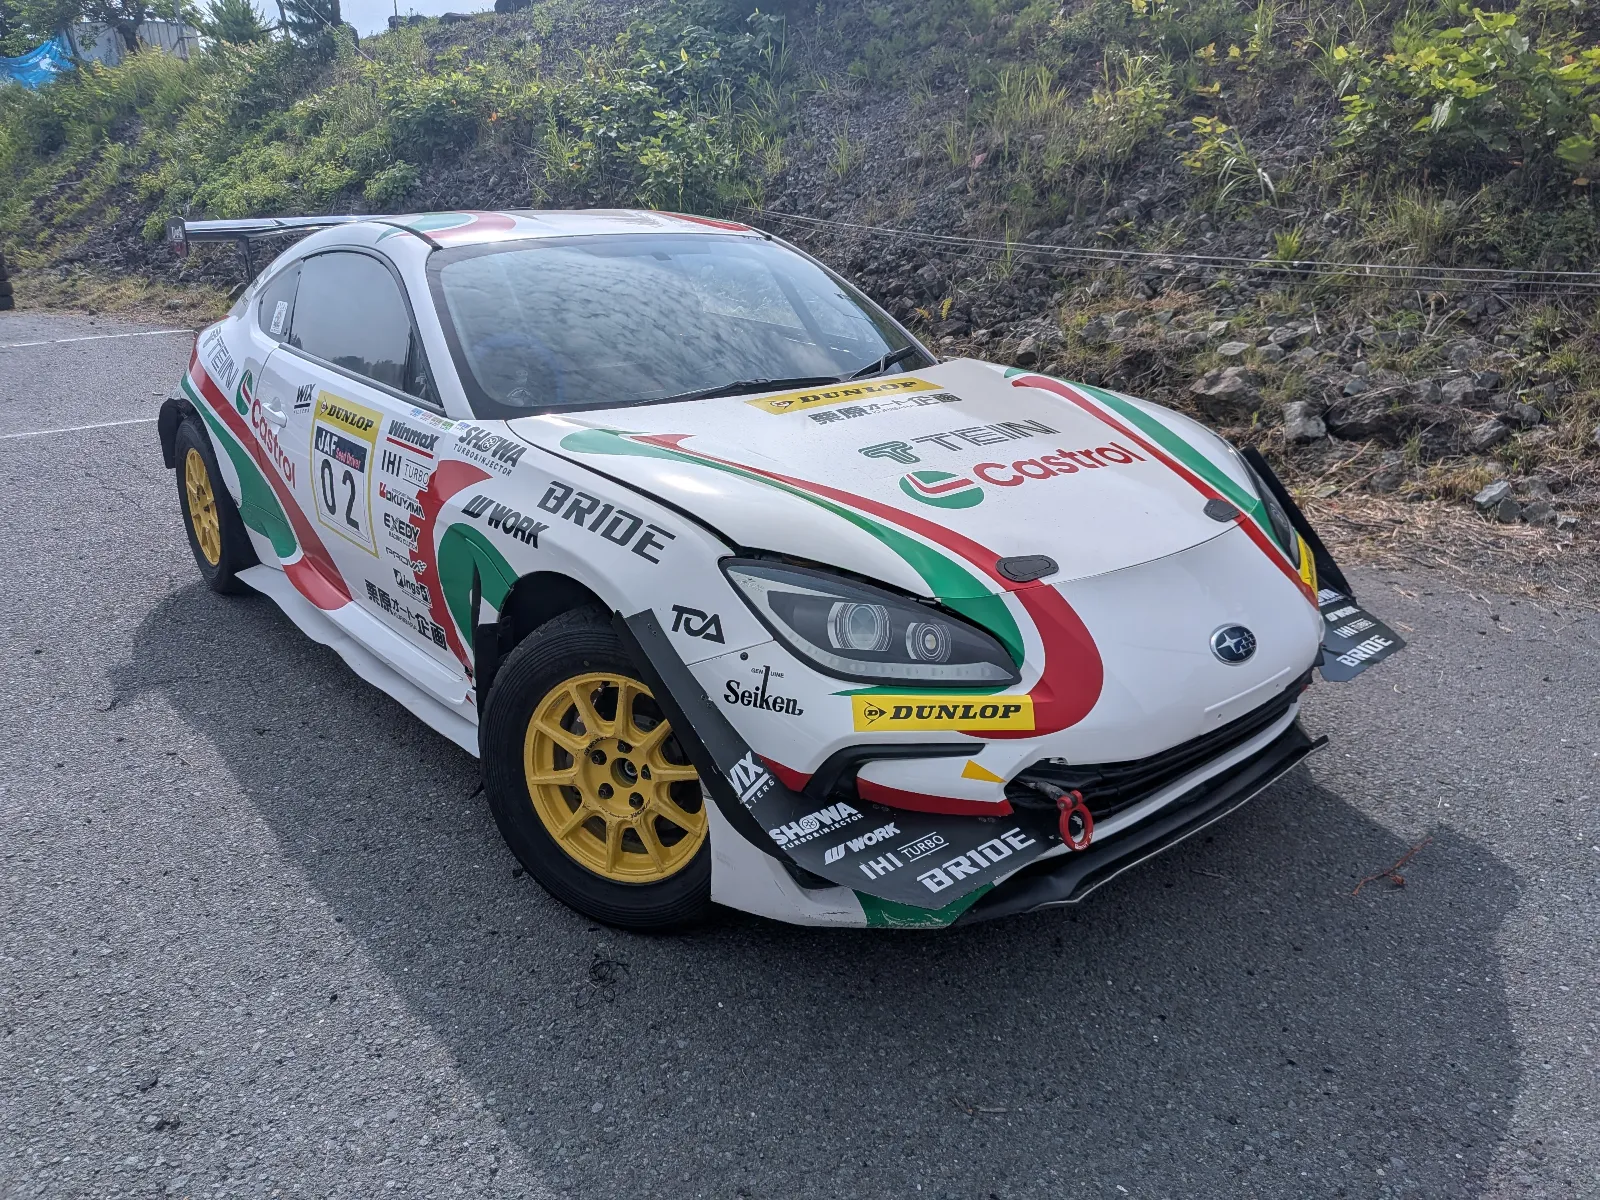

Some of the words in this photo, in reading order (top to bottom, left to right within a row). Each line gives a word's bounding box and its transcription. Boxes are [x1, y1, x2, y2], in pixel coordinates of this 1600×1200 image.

[207, 335, 239, 391] TEIN
[296, 383, 316, 403] WIX
[801, 380, 917, 403] DUNLOP
[327, 404, 375, 432] DUNLOP
[909, 419, 1062, 451] TEIN
[252, 398, 296, 490] Castrol
[318, 430, 338, 456] JAF
[453, 443, 512, 477] TURBO&INJECTOR
[381, 449, 402, 478] IHI
[404, 463, 430, 485] TURBO
[973, 441, 1147, 487] Castrol
[320, 458, 360, 531] 02
[384, 512, 419, 542] EXEDY
[487, 502, 550, 549] WORK
[537, 480, 677, 565] BRIDE
[1336, 634, 1394, 667] BRIDE
[723, 664, 804, 716] Seiken
[889, 704, 1023, 720] DUNLOP
[768, 801, 859, 846] SHOWA
[780, 812, 864, 851] TURBO&INJECTOR
[846, 821, 900, 853] WORK
[858, 852, 904, 881] IHI
[900, 834, 946, 861] TURBO
[916, 827, 1037, 893] BRIDE
